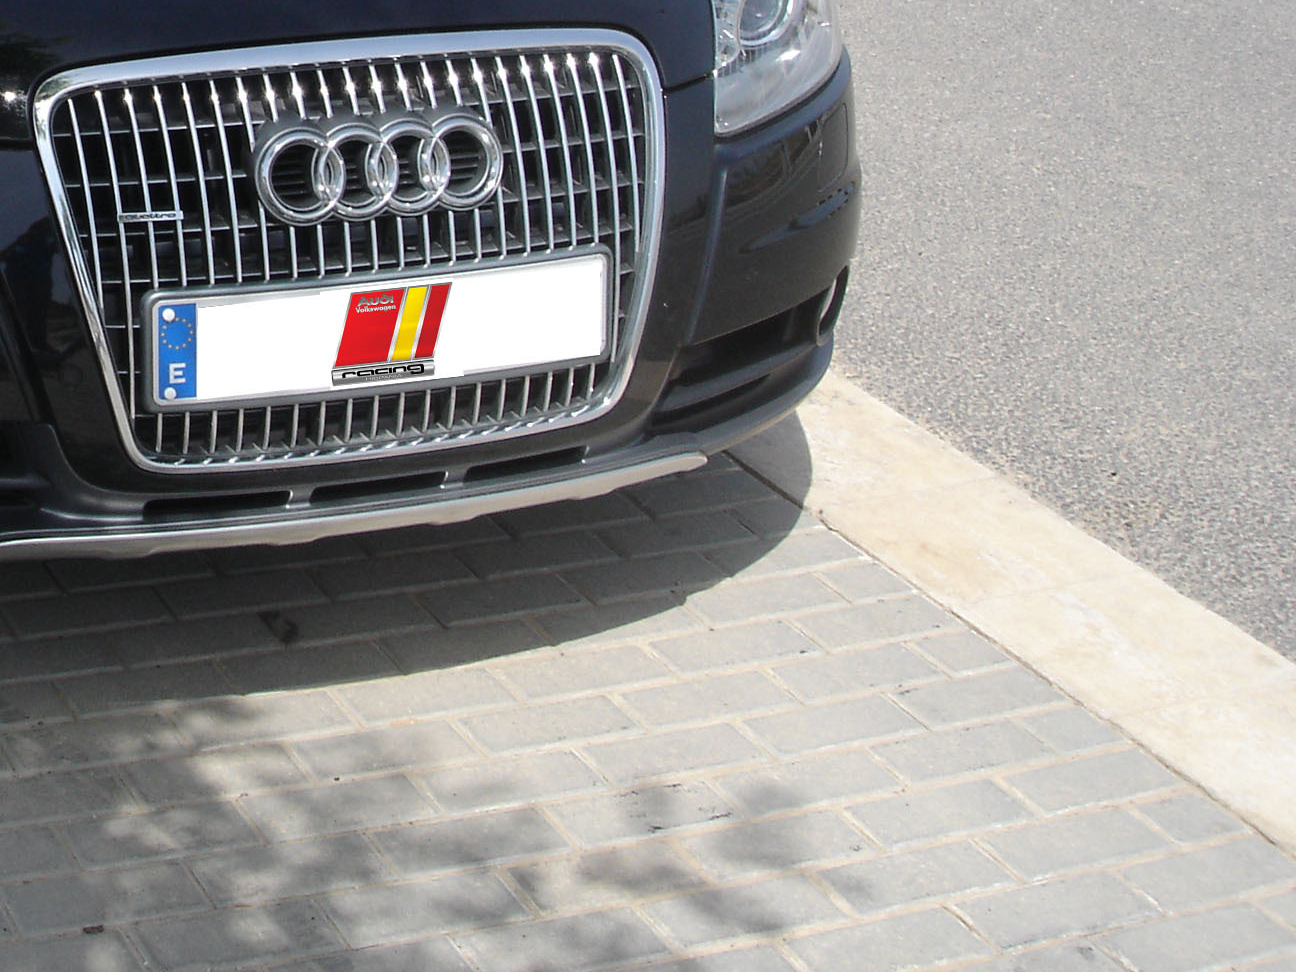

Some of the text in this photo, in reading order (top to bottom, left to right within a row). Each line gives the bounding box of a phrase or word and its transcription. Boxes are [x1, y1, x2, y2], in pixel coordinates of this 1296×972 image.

[355, 304, 397, 314] Volkswagen
[168, 362, 187, 384] E
[341, 363, 425, 379] racing
